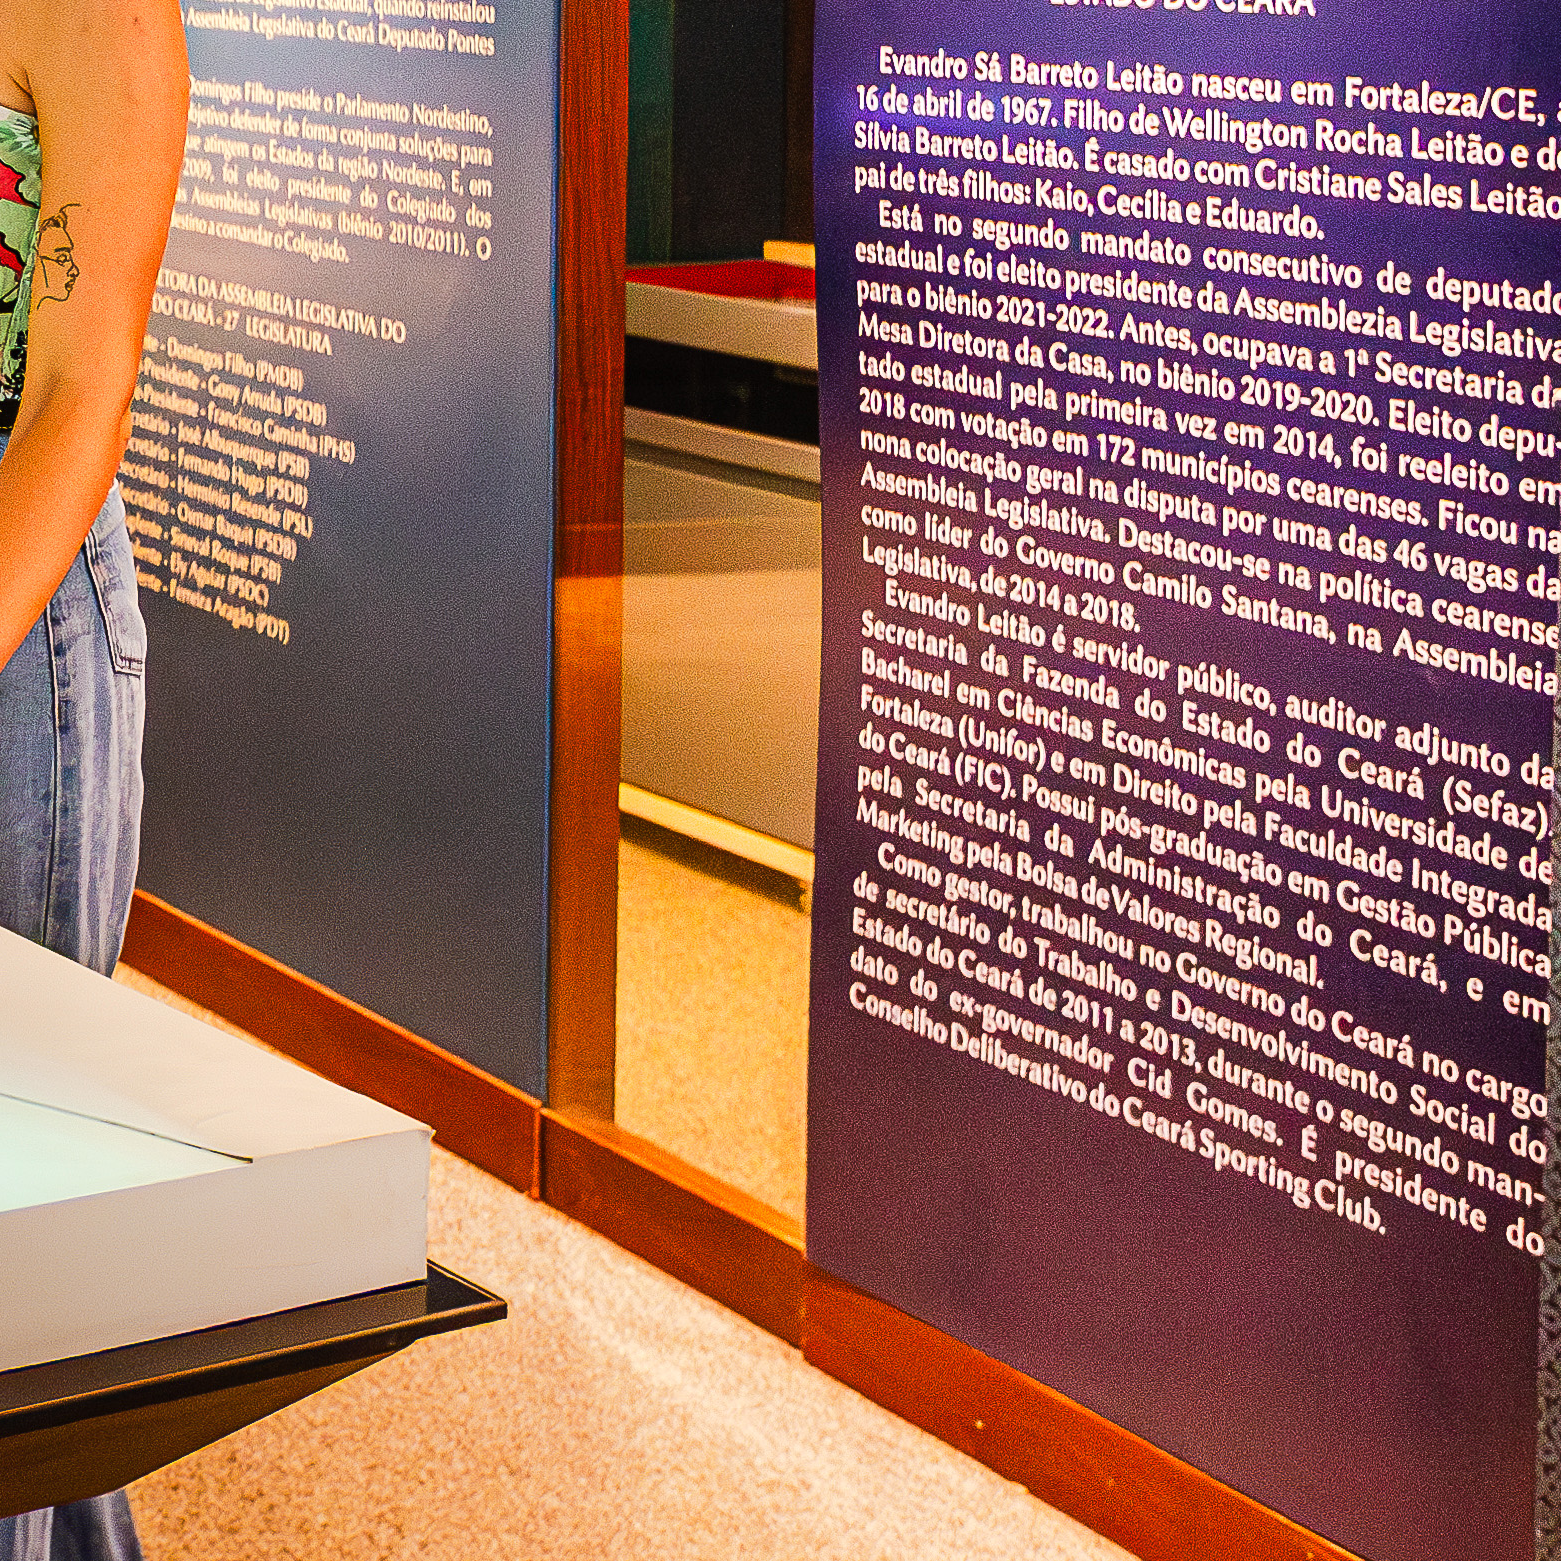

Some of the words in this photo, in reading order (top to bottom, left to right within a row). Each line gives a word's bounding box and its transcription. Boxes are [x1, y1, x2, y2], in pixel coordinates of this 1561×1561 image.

[856, 84, 878, 111] 16
[882, 83, 908, 114] de
[912, 86, 961, 118] abril
[966, 90, 995, 121] de
[1001, 95, 1057, 126] 1967.
[1064, 98, 1123, 132] Filho
[1129, 102, 1159, 135] de
[1162, 106, 1307, 153] Wellington
[1315, 118, 1402, 157] Rocha
[1411, 127, 1503, 165] Leitão
[1511, 144, 1528, 168] e
[879, 45, 967, 79] Evandro
[974, 51, 1002, 82] Sá
[1010, 53, 1098, 89] Barreto
[1106, 60, 1183, 95] Leitão
[1191, 73, 1281, 102] nasceu
[1290, 81, 1333, 106] em
[1345, 76, 1544, 126] Fortaleza/CE,
[854, 161, 885, 193] pai
[889, 162, 914, 191] de
[918, 168, 959, 196] três
[962, 168, 1030, 204] filhos:
[1035, 177, 1093, 216] Kaio,
[1097, 185, 1182, 223] Cecília
[1186, 202, 1200, 224] e
[1206, 196, 1324, 239] Eduardo.
[245, 315, 331, 355] LEGISLATURA
[295, 298, 376, 337] LEGISLATIVA
[381, 317, 405, 343] DO
[859, 386, 905, 418] 2018
[909, 402, 954, 429] com
[960, 411, 1047, 448] votação
[1052, 430, 1087, 456] em
[1096, 433, 1135, 466] 172
[1141, 447, 1280, 495] municípios
[1287, 477, 1427, 526] cearenses.
[1438, 499, 1516, 544] Ficou
[1528, 526, 1558, 553] na
[862, 535, 977, 592] Legislativa,
[980, 565, 1006, 597] de
[1009, 573, 1060, 610] 2014
[1063, 593, 1078, 616] a
[1080, 592, 1140, 632] 2018.
[861, 609, 967, 665] Secretaria
[980, 643, 1008, 676] da
[1022, 655, 1119, 709] Fazenda
[1134, 687, 1166, 721] do
[1182, 700, 1270, 752] Estado
[1286, 732, 1320, 767] do
[1337, 747, 1423, 799] Ceará
[861, 684, 953, 738] Fortaleza
[958, 714, 1045, 771] (Unifor)
[1050, 750, 1064, 773] e
[1069, 757, 1105, 786] em
[1113, 762, 1196, 815] Direito
[1203, 799, 1256, 835] pela
[1265, 811, 1402, 882] Faculdade
[1412, 858, 1551, 931] Integrada
[849, 982, 947, 1043] Conselho
[951, 1022, 1086, 1102] Deliberativo
[1089, 1082, 1119, 1116] do
[1122, 1096, 1195, 1151] Ceará
[1199, 1128, 1310, 1208] Sporting
[1314, 1179, 1385, 1234] Club.
